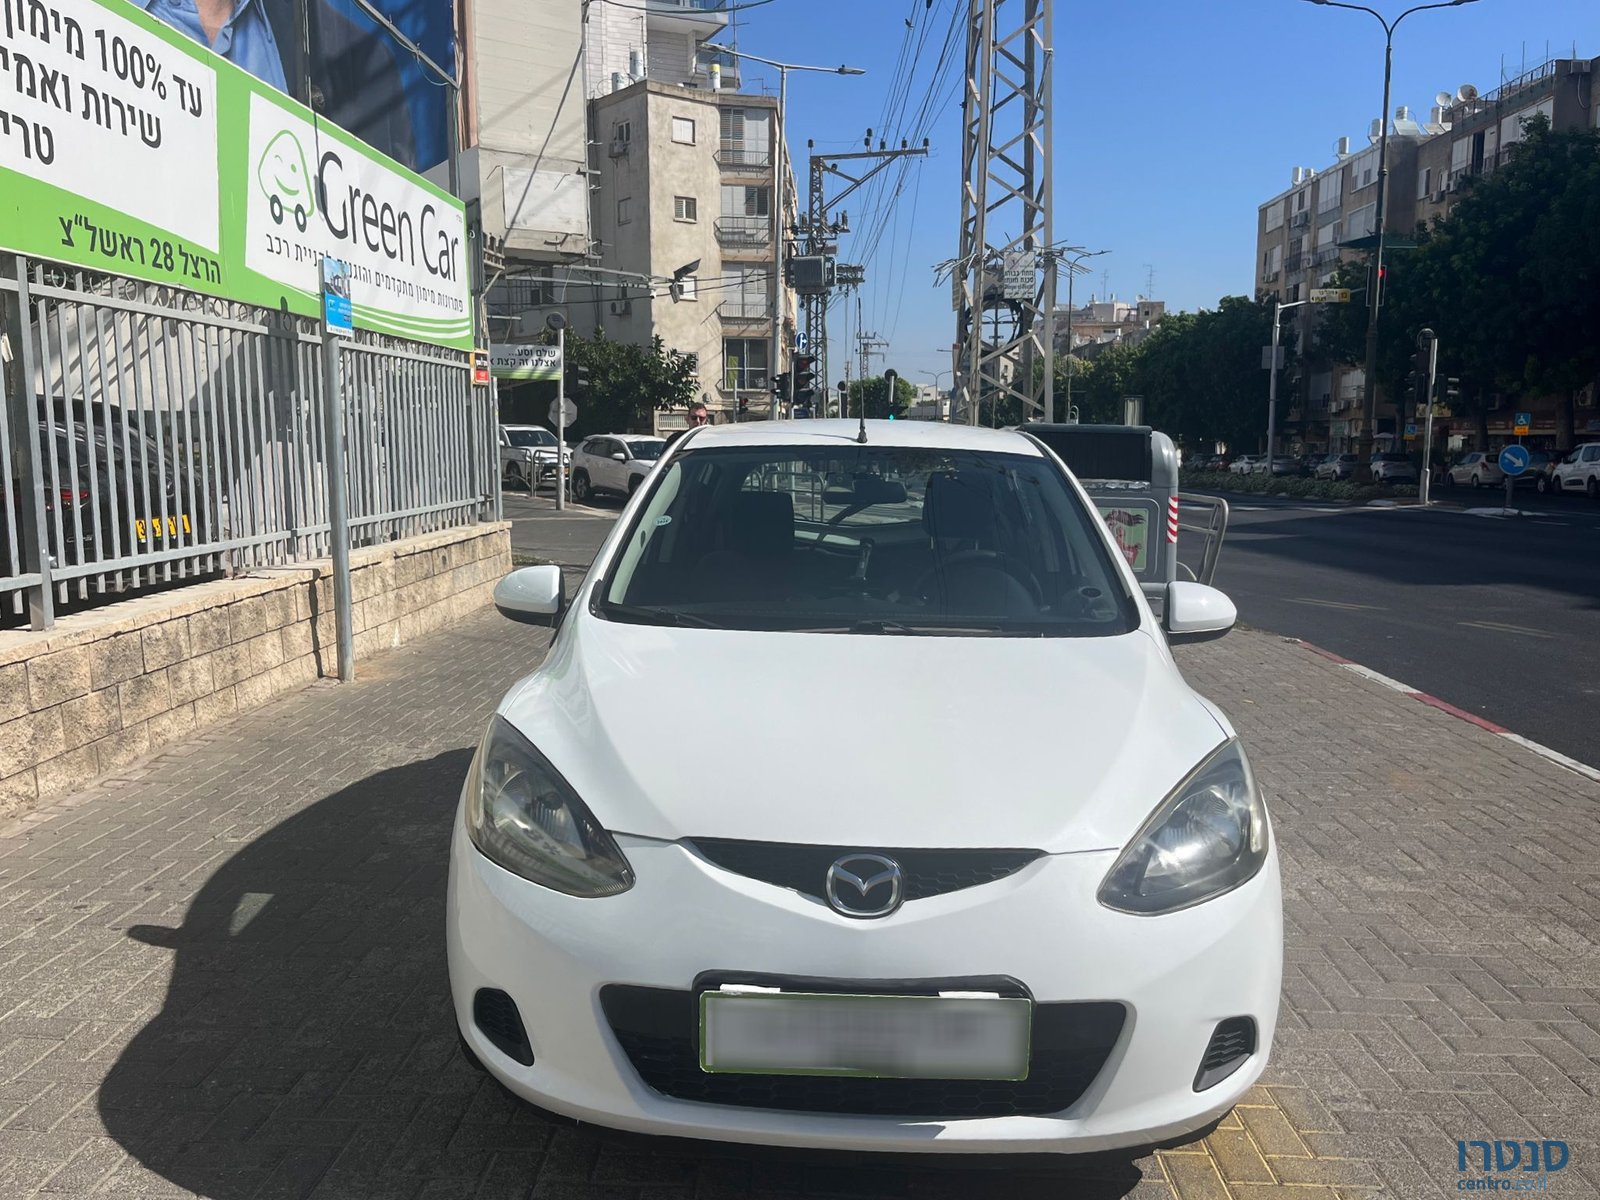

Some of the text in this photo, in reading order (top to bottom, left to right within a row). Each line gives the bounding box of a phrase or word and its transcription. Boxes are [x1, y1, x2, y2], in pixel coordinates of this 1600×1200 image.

[4, 0, 202, 118] עד 100% מימון
[81, 82, 161, 149] שירות
[318, 151, 459, 283] Green Car
[58, 213, 221, 284] הרצל 28 ראשל"צ
[265, 233, 290, 259] רכב
[337, 258, 371, 285] והוגנ
[375, 271, 414, 298] מתקדמים
[415, 284, 436, 304] מימון
[437, 292, 463, 313] פתרונות
[496, 357, 516, 368] קצת
[519, 358, 529, 366] זה
[531, 358, 556, 367] אצלנו
[535, 348, 556, 358] שלם
